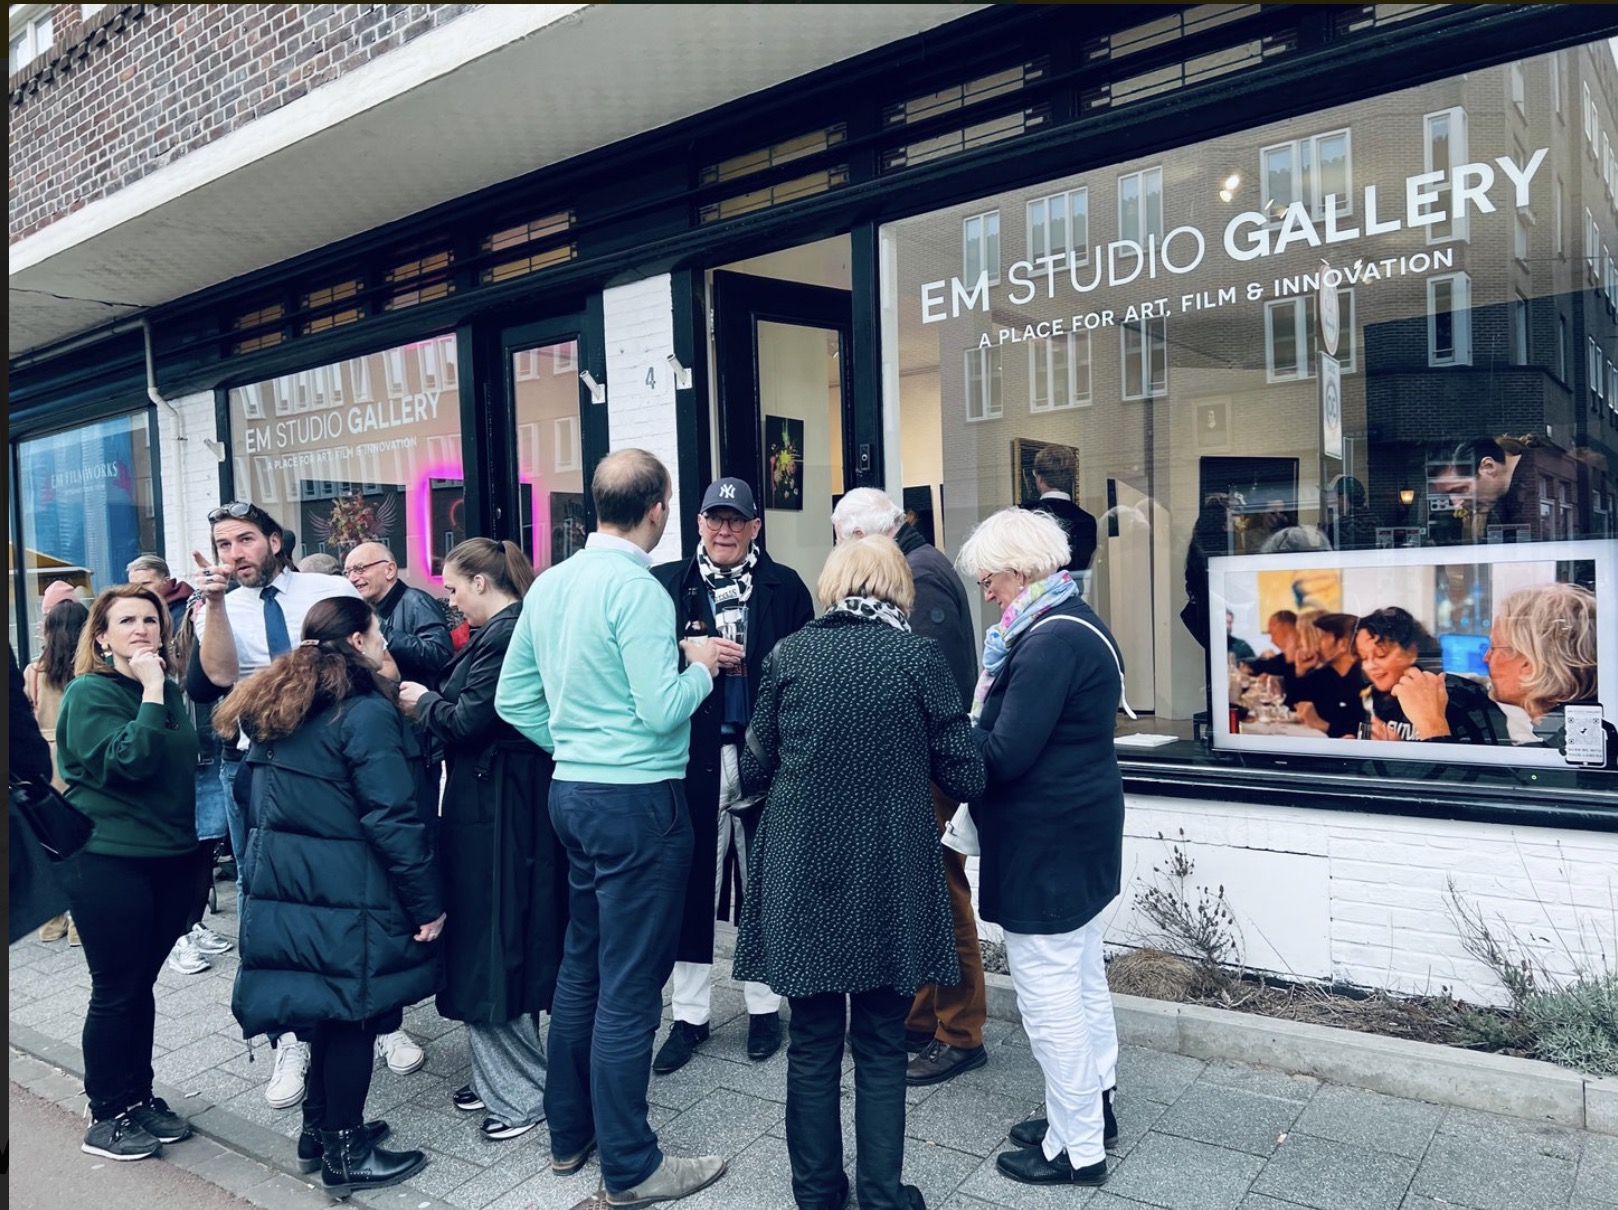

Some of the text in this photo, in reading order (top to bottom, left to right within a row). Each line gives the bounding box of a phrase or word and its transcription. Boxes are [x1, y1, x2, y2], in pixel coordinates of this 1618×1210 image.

[921, 147, 1550, 324] EM STUDIO GALLERY
[979, 248, 1453, 349] A PLACE FOR ART, FILM & INNOVATION
[645, 366, 656, 390] 4
[245, 391, 442, 454] EM STUDIO GALLERY
[275, 456, 298, 470] PLACE
[299, 453, 314, 466] FOR
[718, 483, 736, 499] NY
